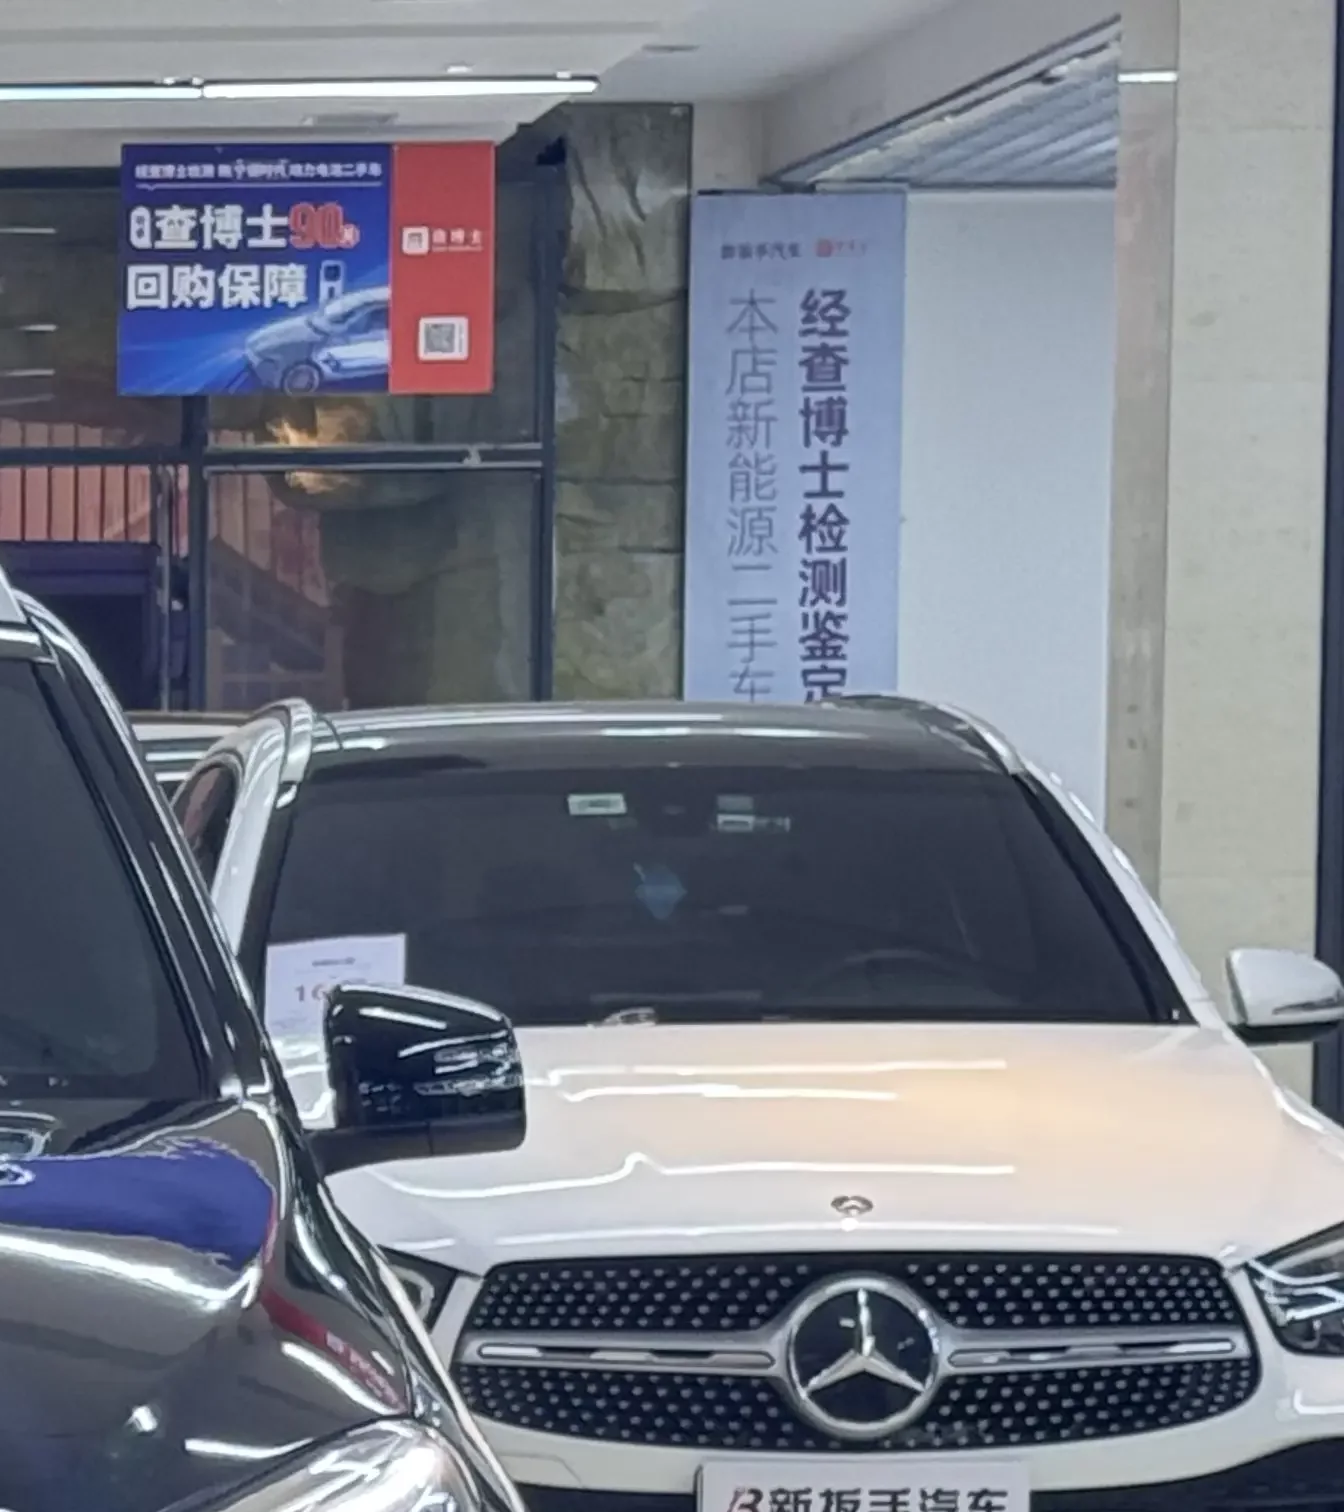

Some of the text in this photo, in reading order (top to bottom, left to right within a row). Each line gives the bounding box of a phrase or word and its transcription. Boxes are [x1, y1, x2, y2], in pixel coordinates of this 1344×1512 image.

[126, 263, 307, 309] 回购保障
[725, 288, 778, 703] 本店新能源二手车
[797, 288, 852, 703] 经查博士检测鉴定
